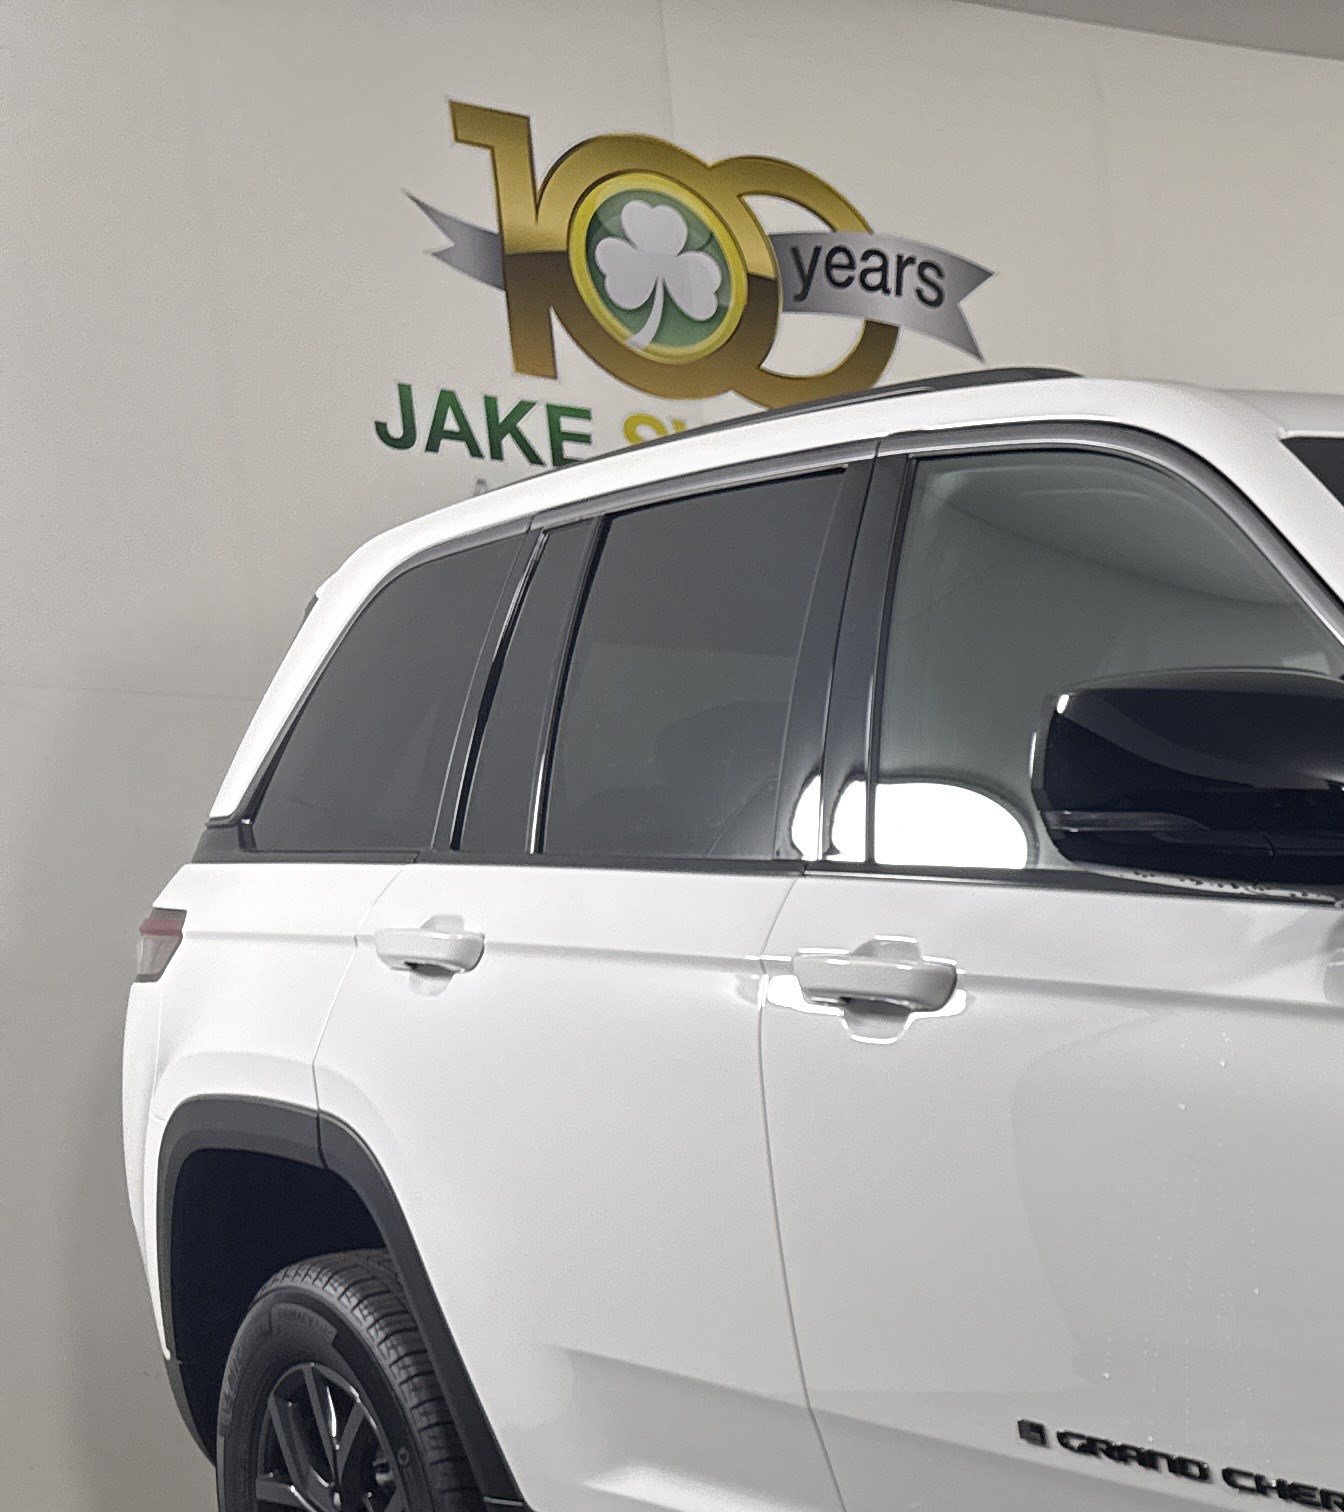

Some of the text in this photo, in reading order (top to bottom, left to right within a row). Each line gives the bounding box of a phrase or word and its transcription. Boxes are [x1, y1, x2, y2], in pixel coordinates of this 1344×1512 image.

[791, 243, 945, 308] years
[374, 382, 593, 467] JAKE
[1056, 1430, 1212, 1482] GRAND
